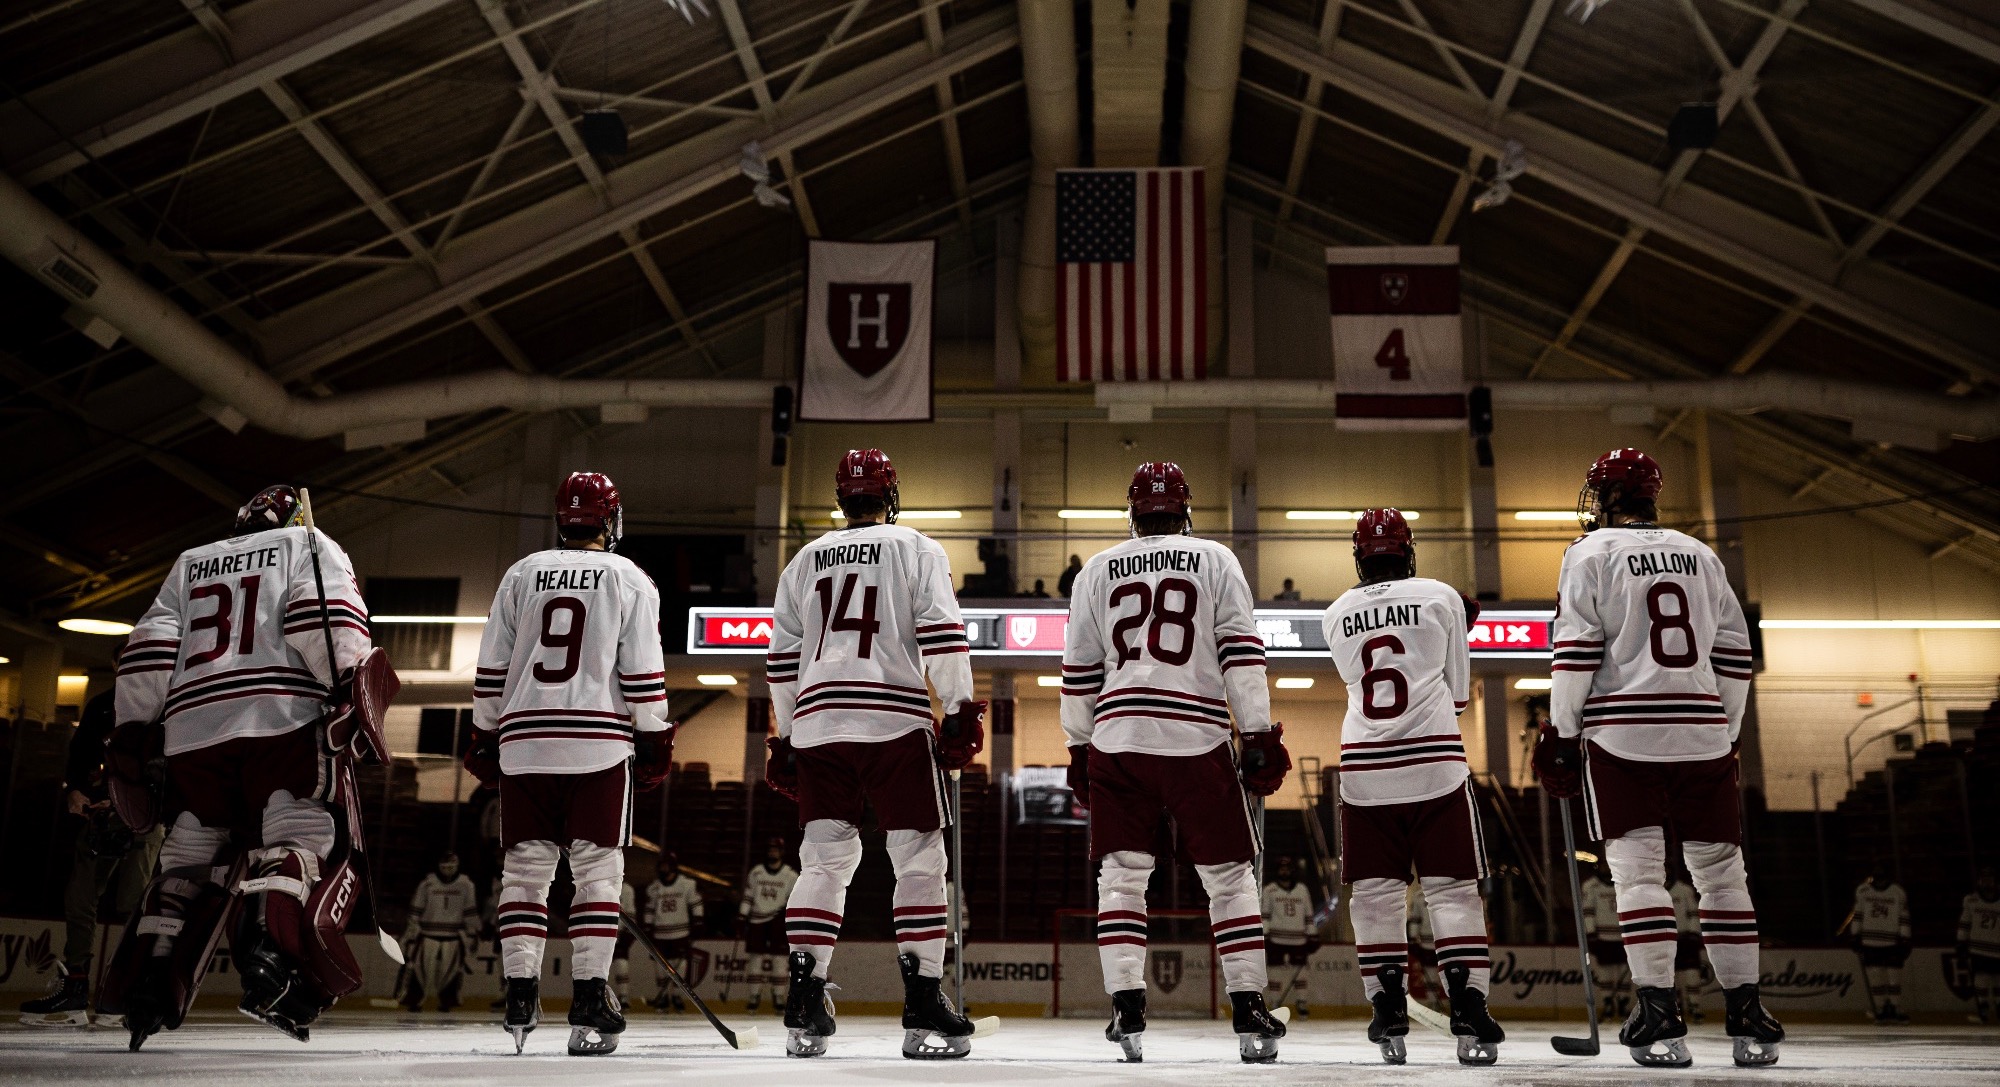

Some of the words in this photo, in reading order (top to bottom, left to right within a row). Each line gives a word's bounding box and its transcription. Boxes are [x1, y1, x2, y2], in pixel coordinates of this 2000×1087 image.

[847, 293, 890, 348] H
[1375, 329, 1411, 380] 4
[853, 466, 863, 476] 14
[1152, 482, 1165, 493] 28
[573, 496, 579, 506] 9
[1376, 525, 1383, 535] 6
[188, 548, 278, 583] CHARETTE
[815, 543, 881, 573] MORDEN
[1108, 550, 1201, 581] RUOHONEN
[1627, 552, 1697, 576] CALLOW
[535, 569, 604, 592] HEALEY
[184, 574, 262, 671] 31
[815, 573, 881, 663] 14
[1109, 578, 1198, 670] 28
[1342, 604, 1422, 638] GALLANT
[1646, 581, 1699, 668] 8
[532, 596, 587, 684] 9
[1361, 634, 1408, 720] 6
[330, 867, 357, 924] CCM
